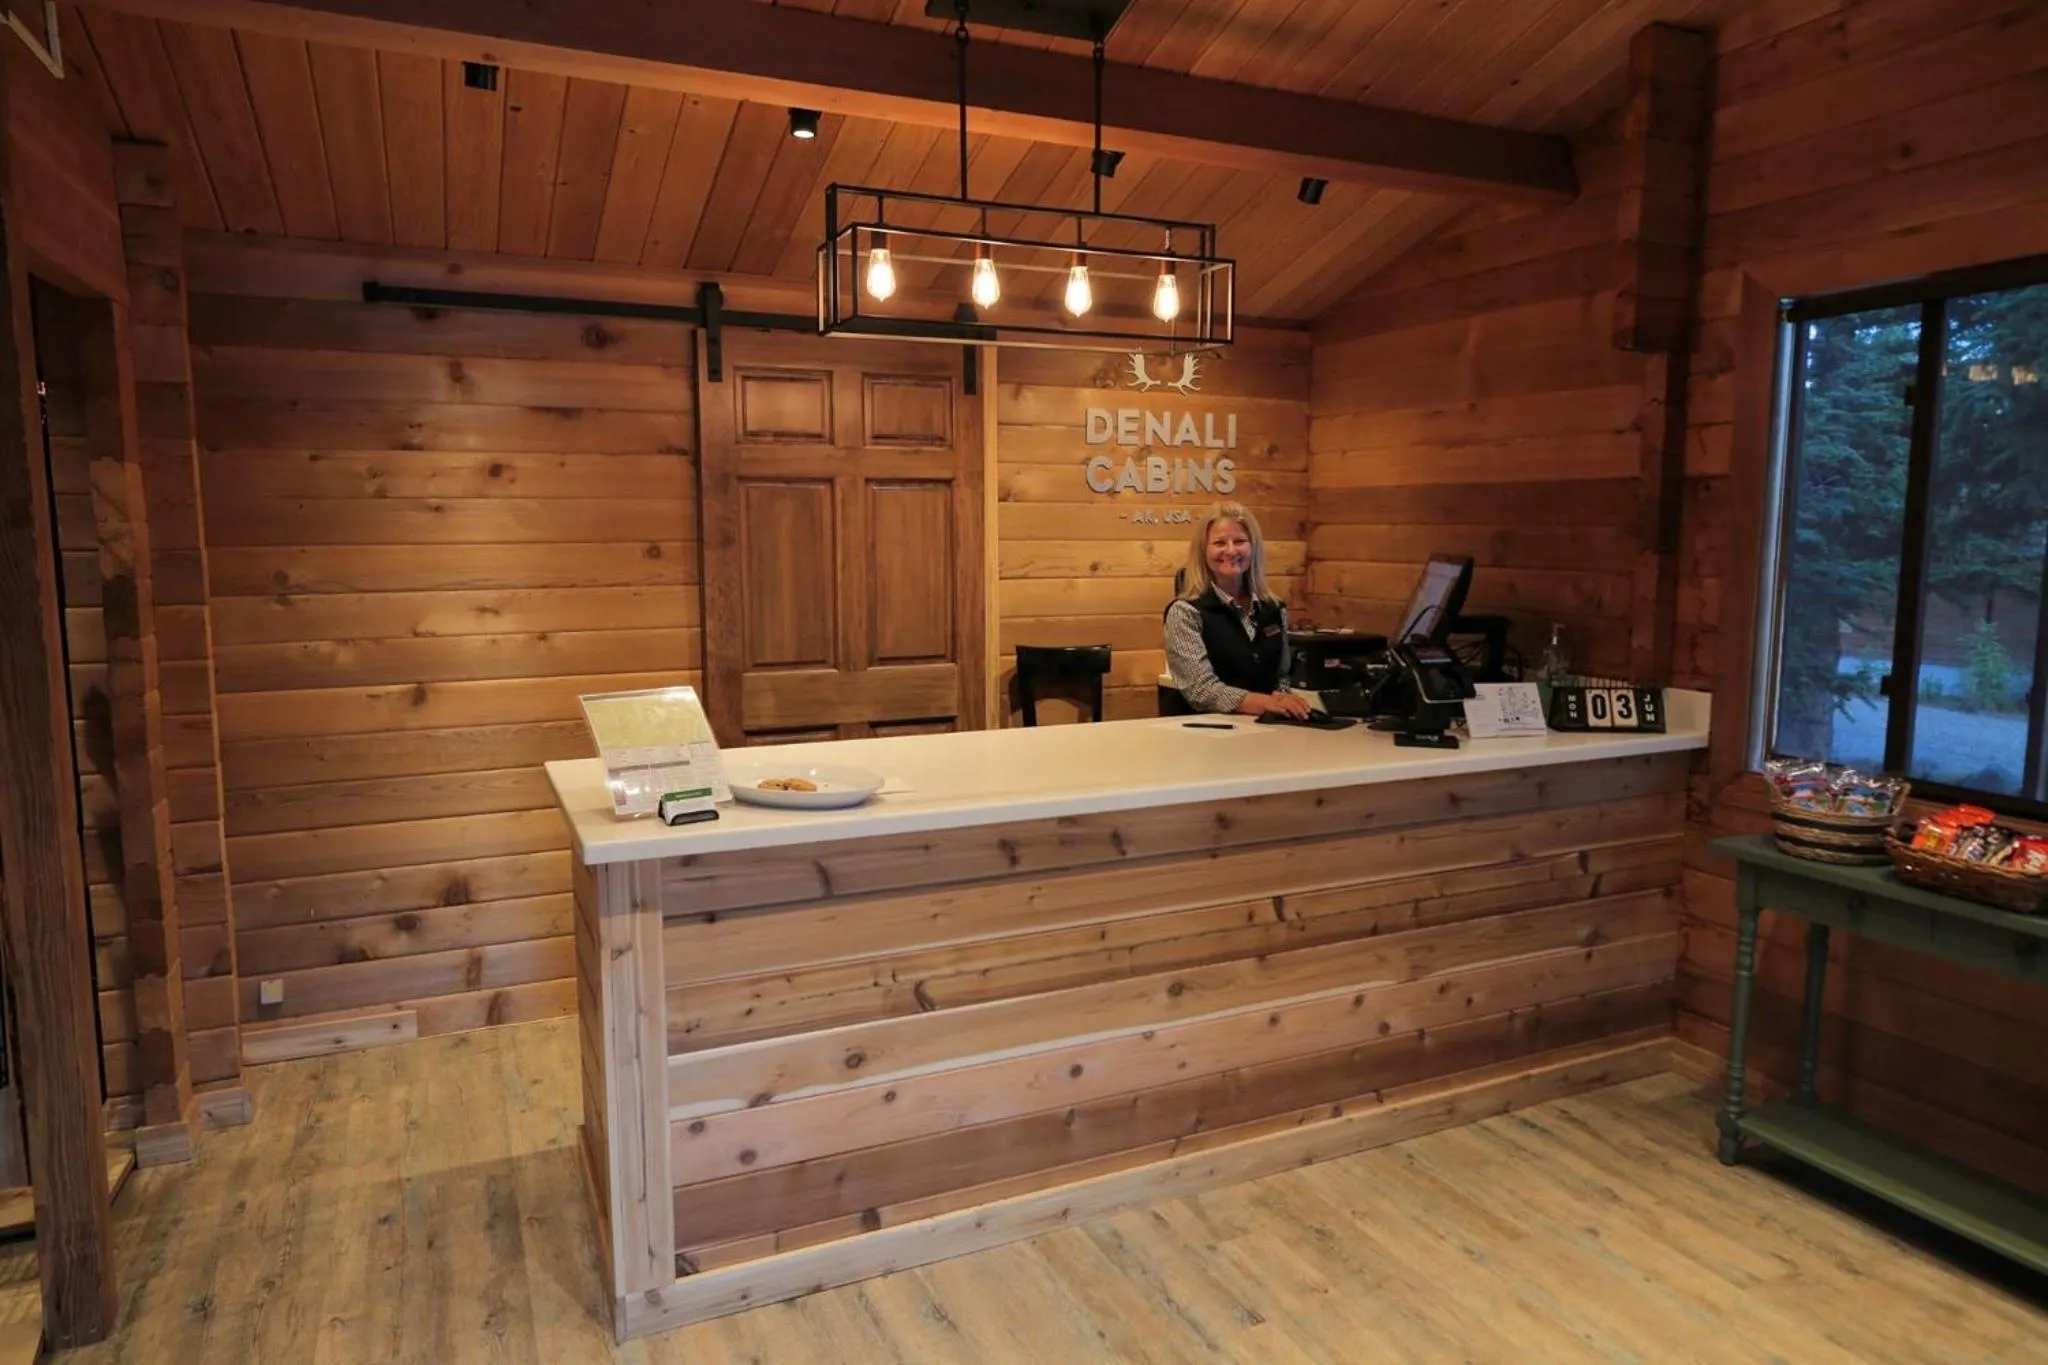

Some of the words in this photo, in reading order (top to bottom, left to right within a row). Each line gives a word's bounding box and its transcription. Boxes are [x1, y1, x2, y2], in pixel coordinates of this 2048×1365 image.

[1086, 407, 1237, 449] DENALI
[1086, 456, 1236, 494] CABINS
[1567, 694, 1578, 719] MON
[1591, 694, 1633, 720] 03
[1643, 693, 1656, 722] JUN
